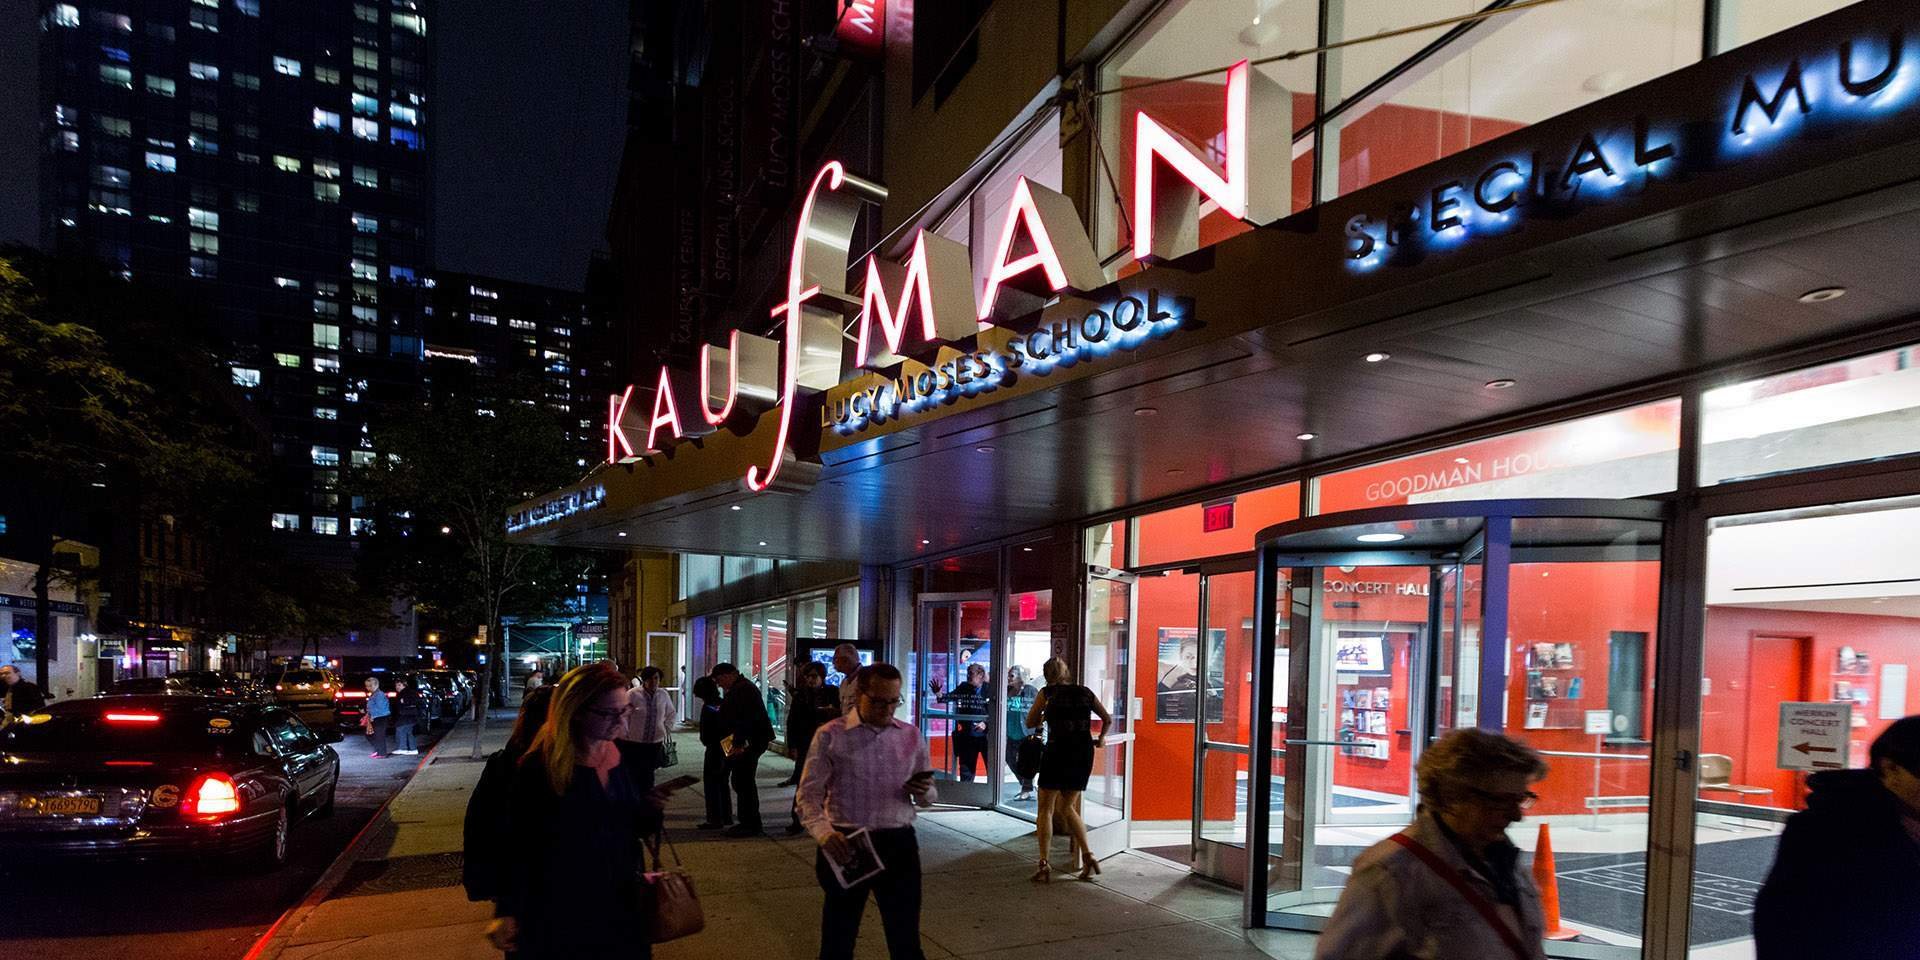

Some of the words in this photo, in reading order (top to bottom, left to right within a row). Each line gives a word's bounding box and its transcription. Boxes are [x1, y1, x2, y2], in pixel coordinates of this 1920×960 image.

[1344, 112, 1673, 260] SPECIAL
[820, 385, 884, 429] LUCY
[894, 350, 991, 402] MOSES
[1007, 289, 1171, 368] SCHOOL
[1366, 463, 1482, 501] GOODMAN
[1493, 450, 1568, 478] HOU
[1323, 580, 1391, 594] CONCERT
[1395, 580, 1431, 596] HALL
[1790, 718, 1841, 727] CONCERT
